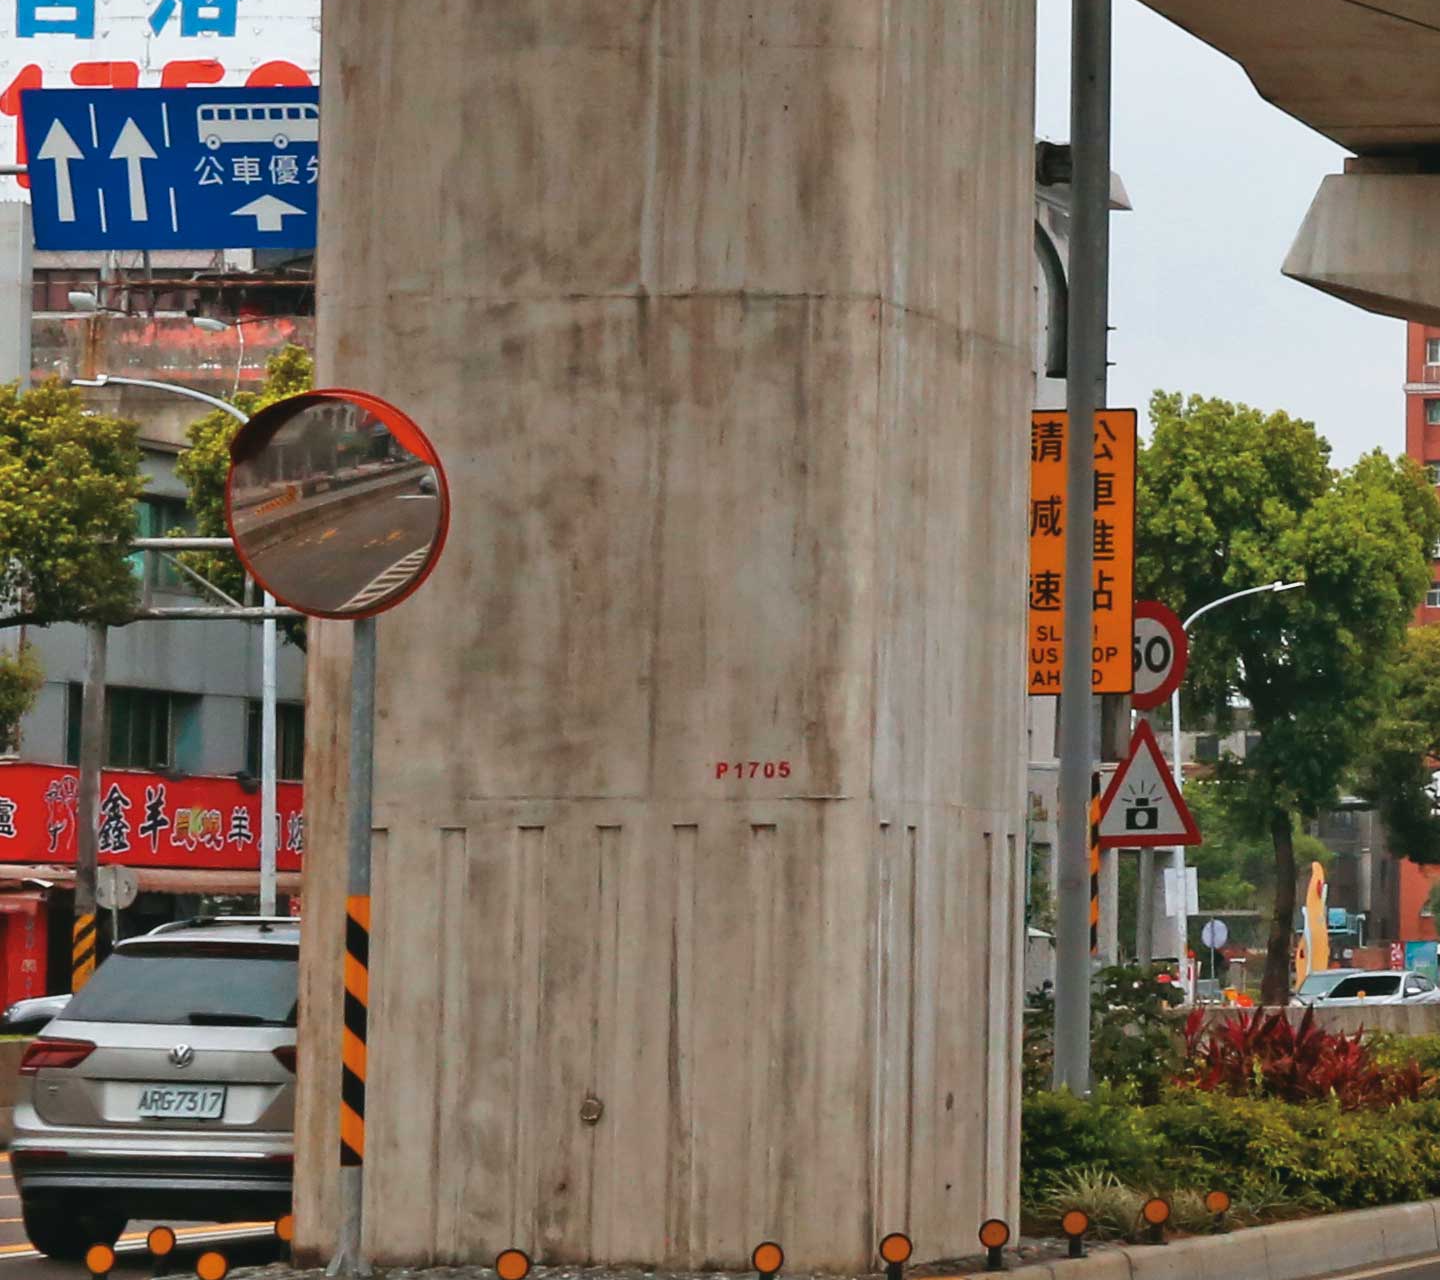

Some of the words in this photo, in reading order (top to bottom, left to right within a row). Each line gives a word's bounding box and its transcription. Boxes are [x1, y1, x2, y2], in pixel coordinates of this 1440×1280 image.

[1036, 625, 1099, 642] SL!
[1031, 648, 1058, 664] US
[1092, 647, 1118, 663] OP
[1031, 670, 1103, 686] AHD
